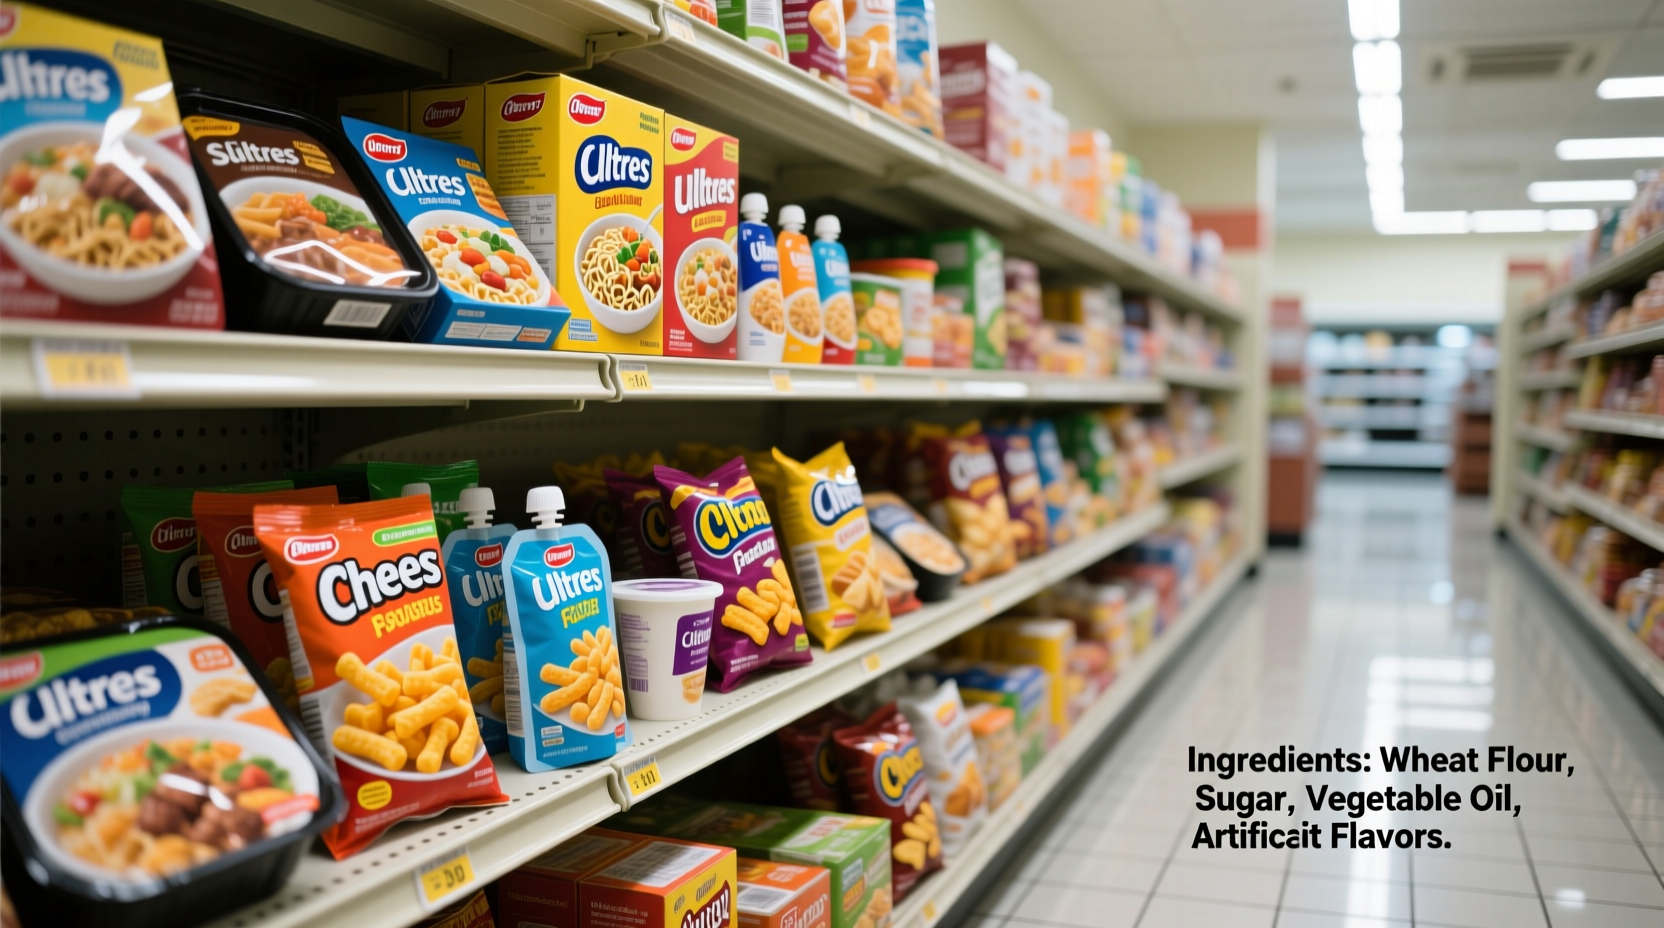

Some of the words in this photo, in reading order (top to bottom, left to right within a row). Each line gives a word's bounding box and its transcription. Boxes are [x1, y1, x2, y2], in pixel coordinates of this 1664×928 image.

[385, 166, 466, 197] Ultres
[580, 142, 650, 186] Ultres
[317, 549, 443, 624] Chees
[532, 567, 603, 612] Ultres
[9, 664, 163, 740] Ultres
